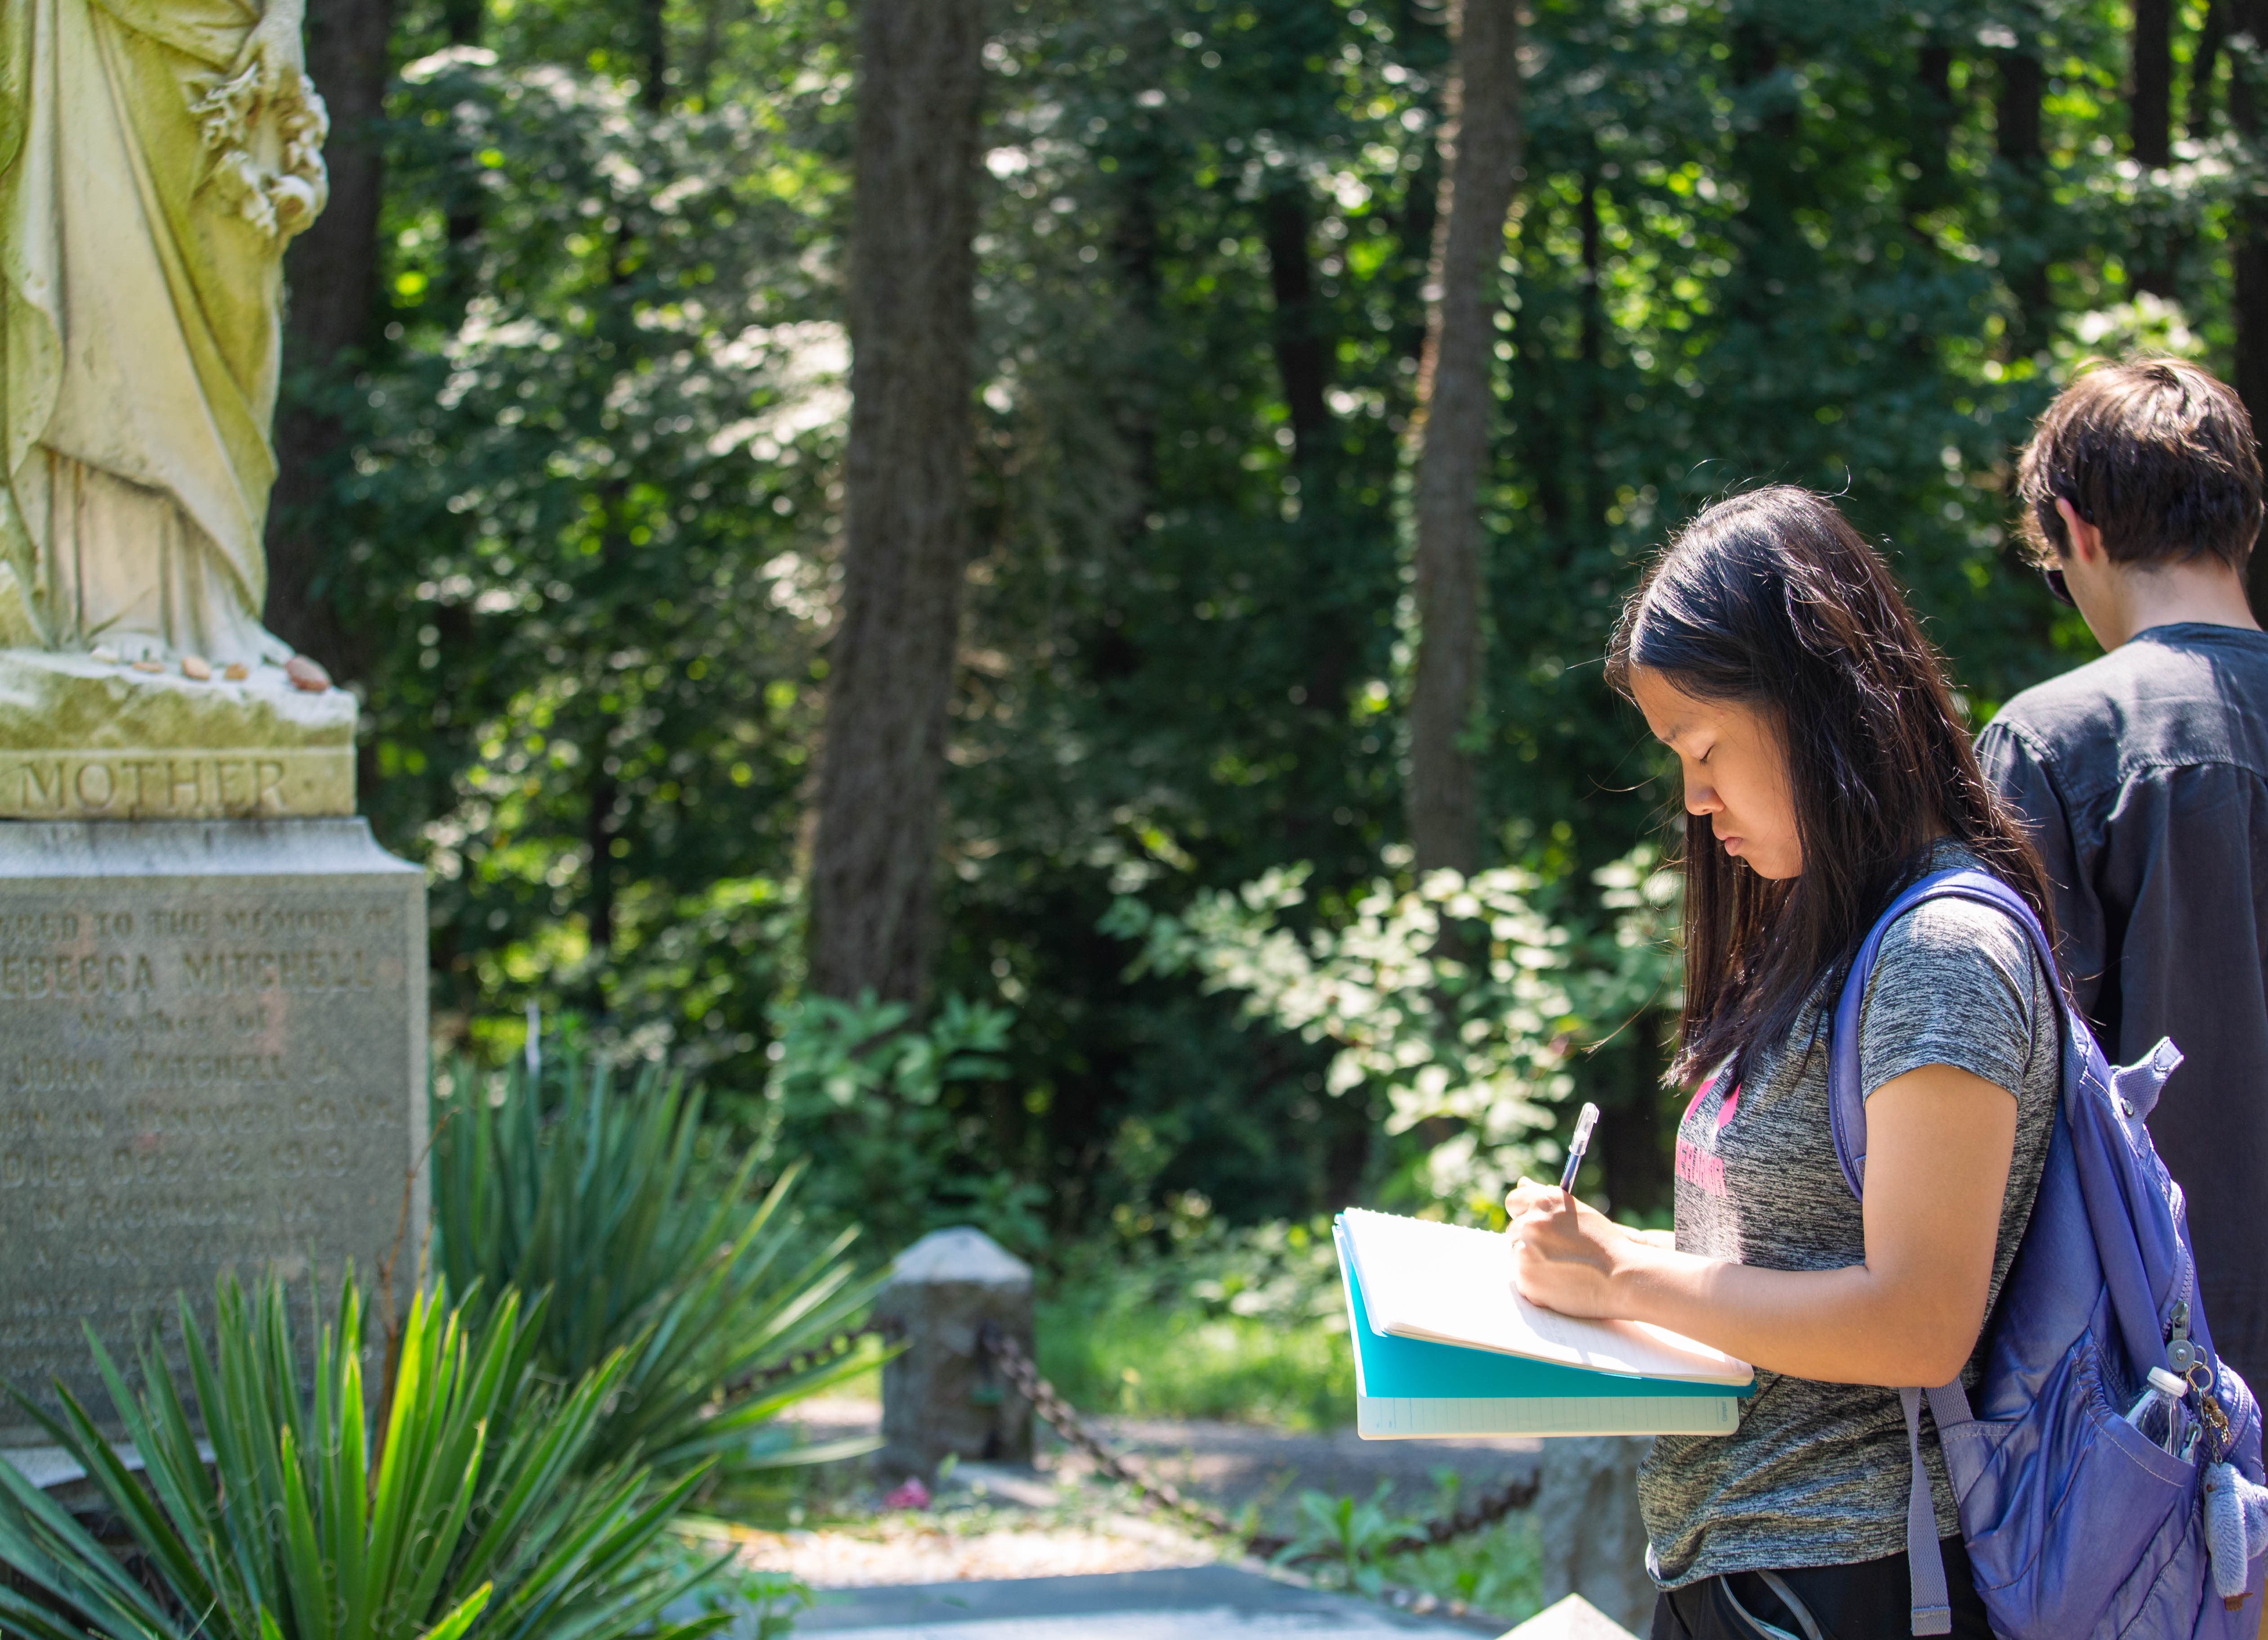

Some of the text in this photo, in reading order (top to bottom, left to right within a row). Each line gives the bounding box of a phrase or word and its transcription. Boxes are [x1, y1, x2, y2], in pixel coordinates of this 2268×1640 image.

[21, 759, 288, 809] MOTHER
[94, 911, 134, 938] TO
[148, 909, 210, 938] THE
[223, 908, 353, 936] MEMORY
[182, 950, 374, 989] MITCHELL
